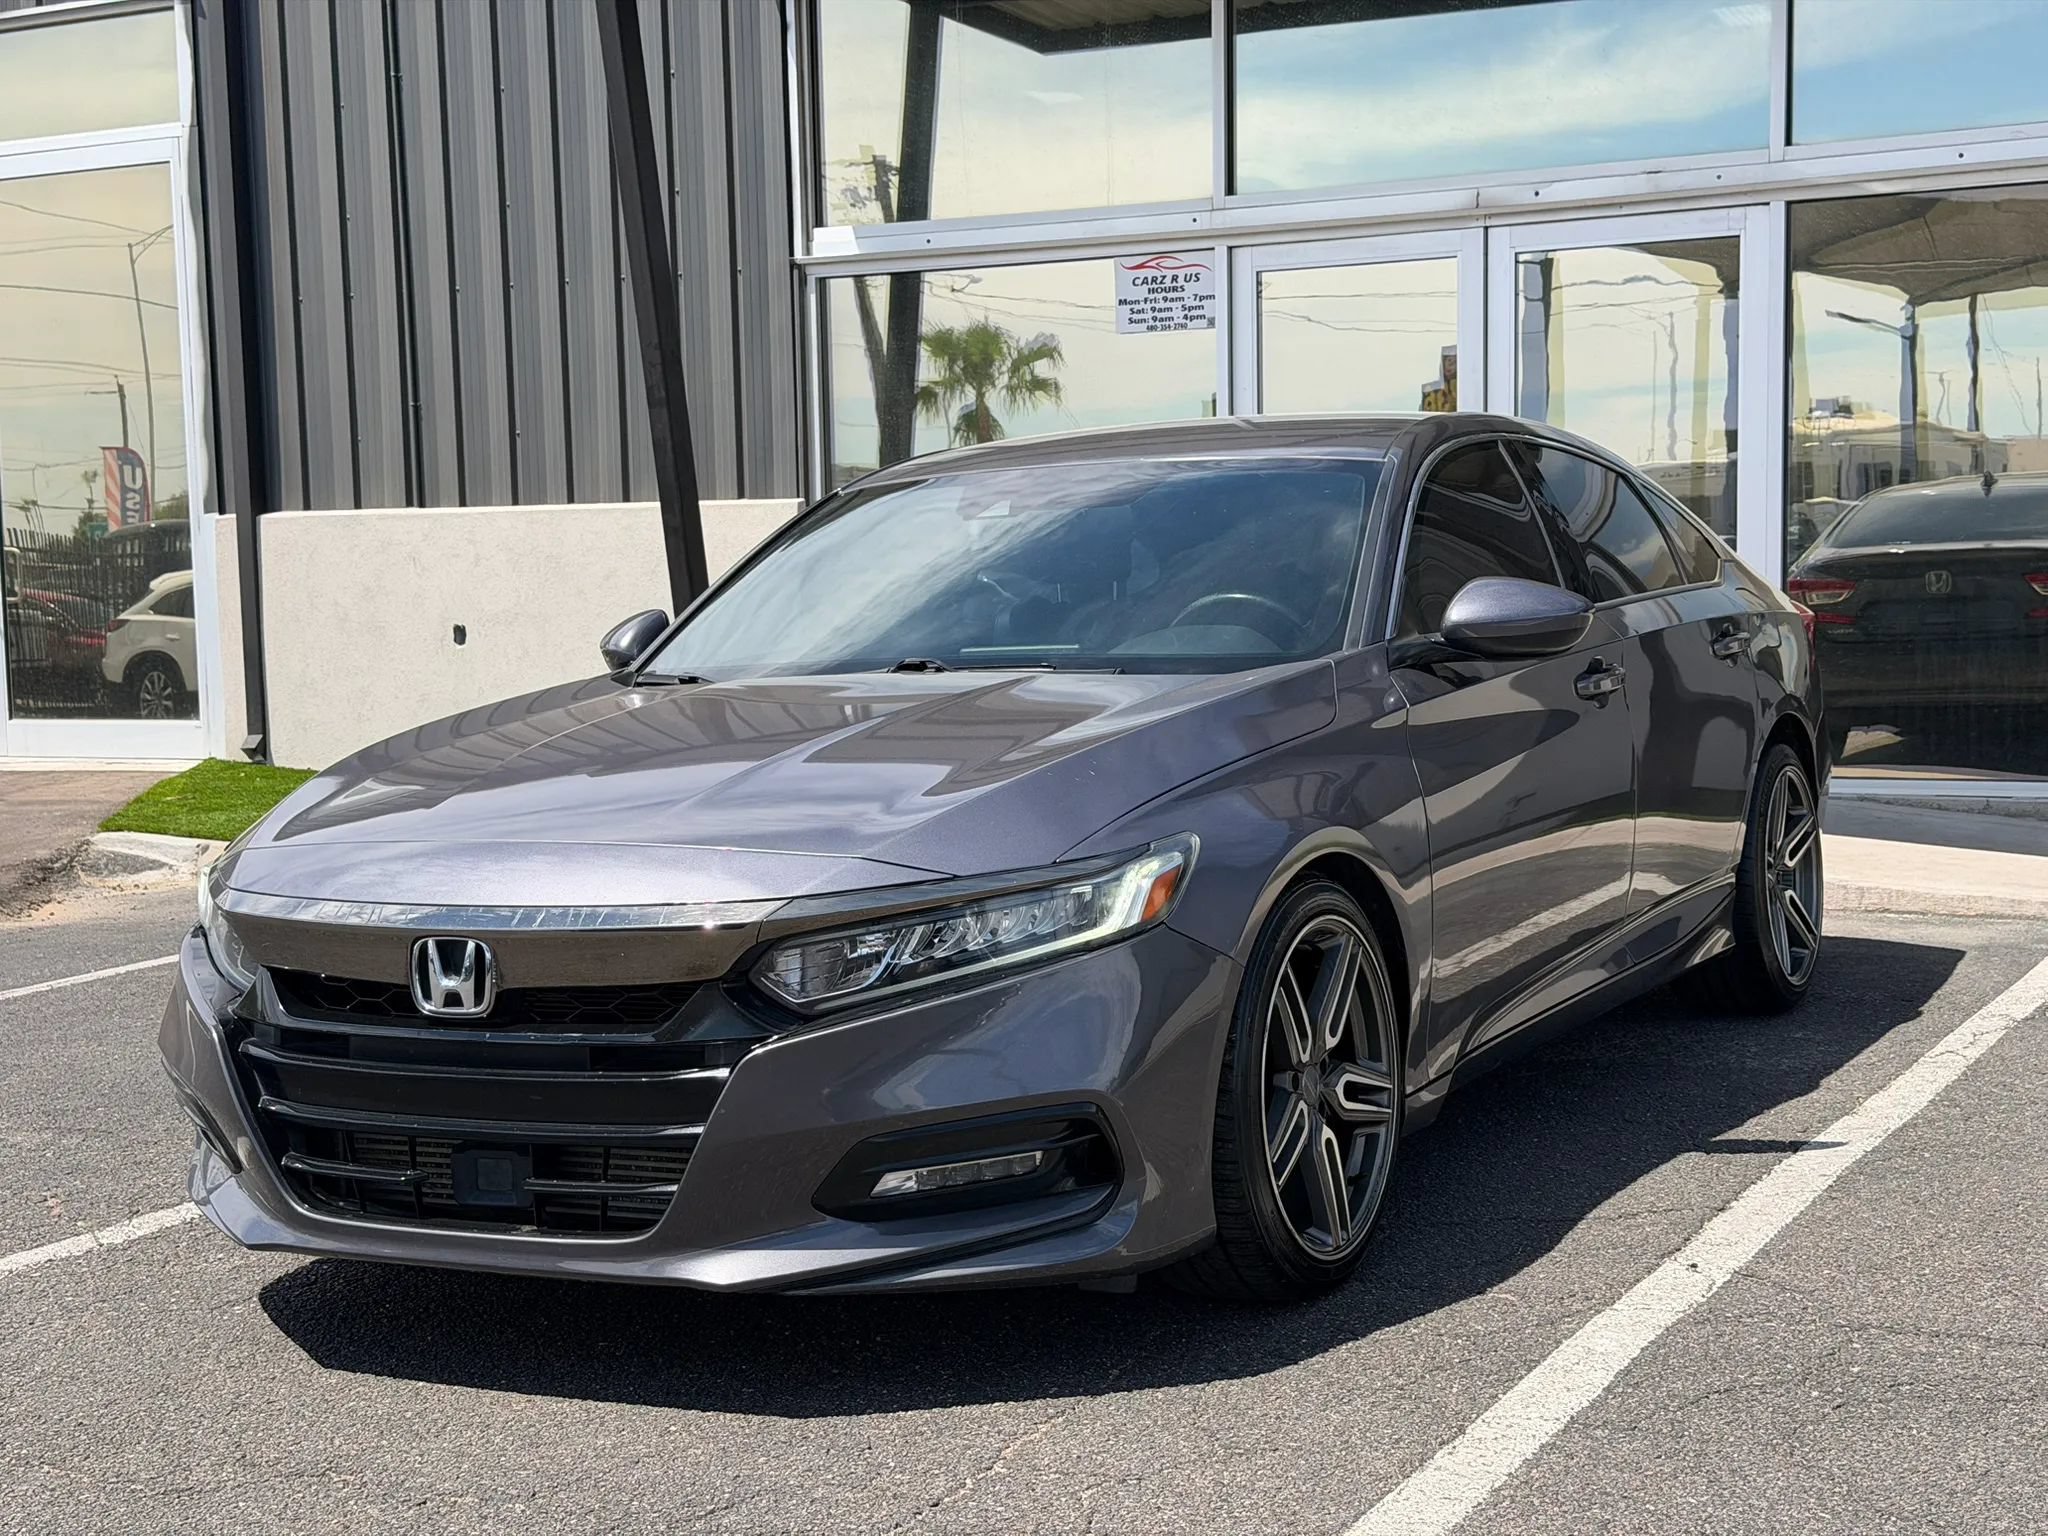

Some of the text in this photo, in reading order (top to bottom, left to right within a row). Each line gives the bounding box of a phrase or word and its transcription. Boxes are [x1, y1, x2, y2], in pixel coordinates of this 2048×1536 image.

[1132, 272, 1201, 287] CARZ R US
[1147, 285, 1186, 295] HOURS
[1118, 297, 1160, 306] Mon-Fri:
[1161, 295, 1185, 304] 9am
[1192, 294, 1216, 302] 7pm
[1129, 307, 1149, 315] Sat:
[1150, 306, 1173, 314] 9am
[1181, 304, 1205, 313] 5pm
[1127, 317, 1150, 325] Sun:
[1151, 315, 1175, 324] 9am
[1182, 313, 1207, 322] 4pm
